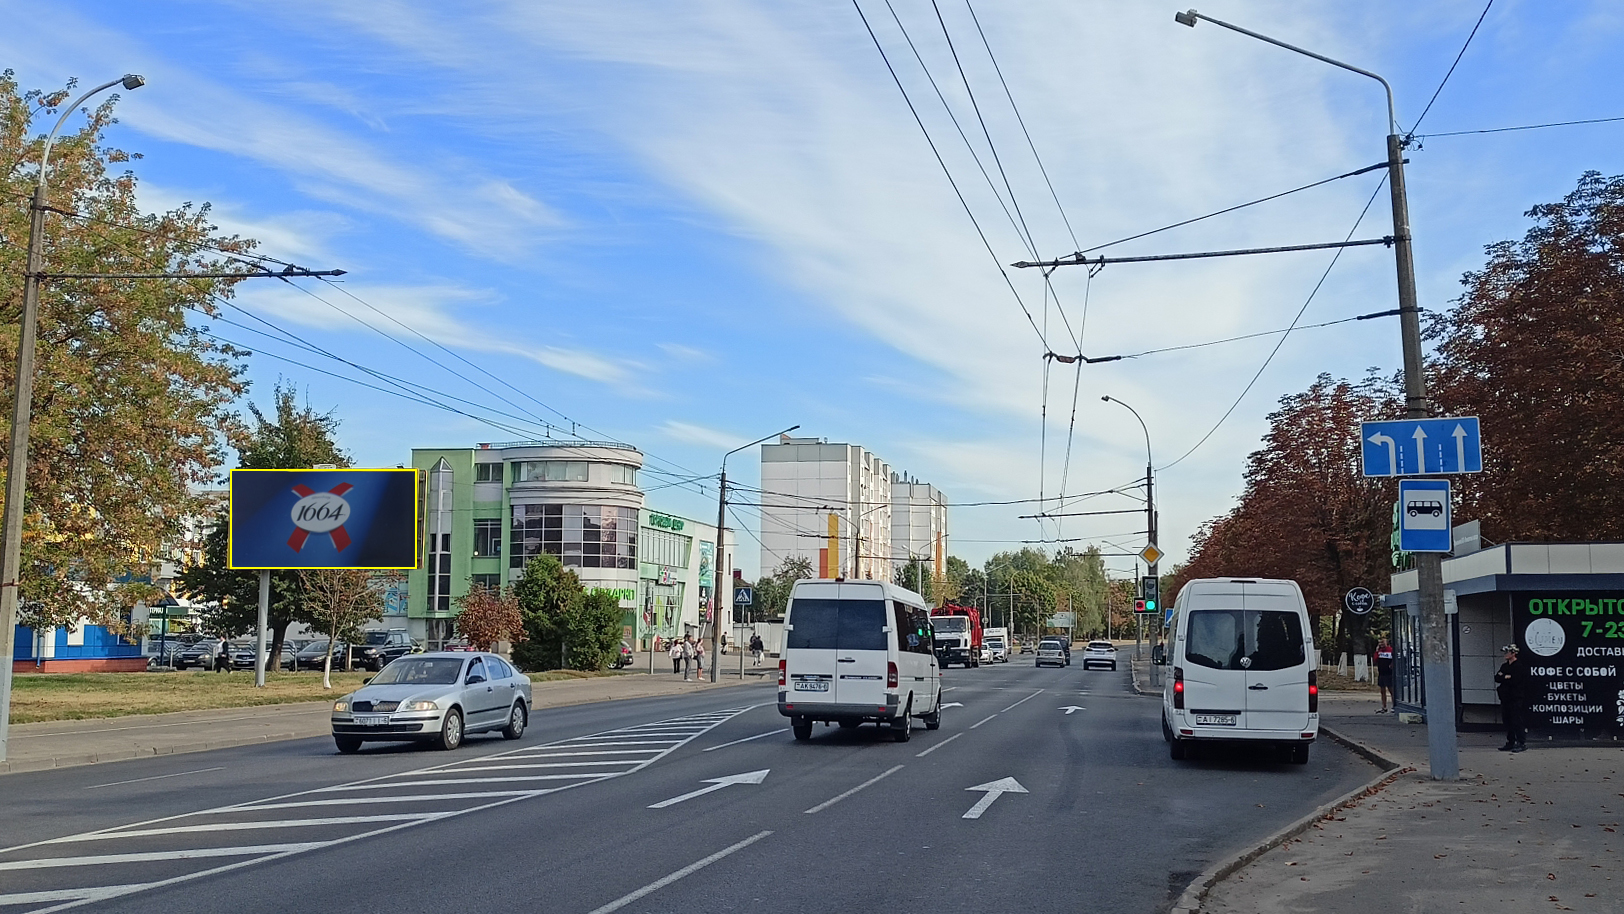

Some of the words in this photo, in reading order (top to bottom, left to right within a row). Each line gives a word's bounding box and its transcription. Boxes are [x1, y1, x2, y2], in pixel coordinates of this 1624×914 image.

[296, 501, 345, 522] 1664
[1530, 666, 1563, 676] КОФЕ
[1565, 667, 1574, 676] С
[1576, 665, 1617, 676] СОБОЙ
